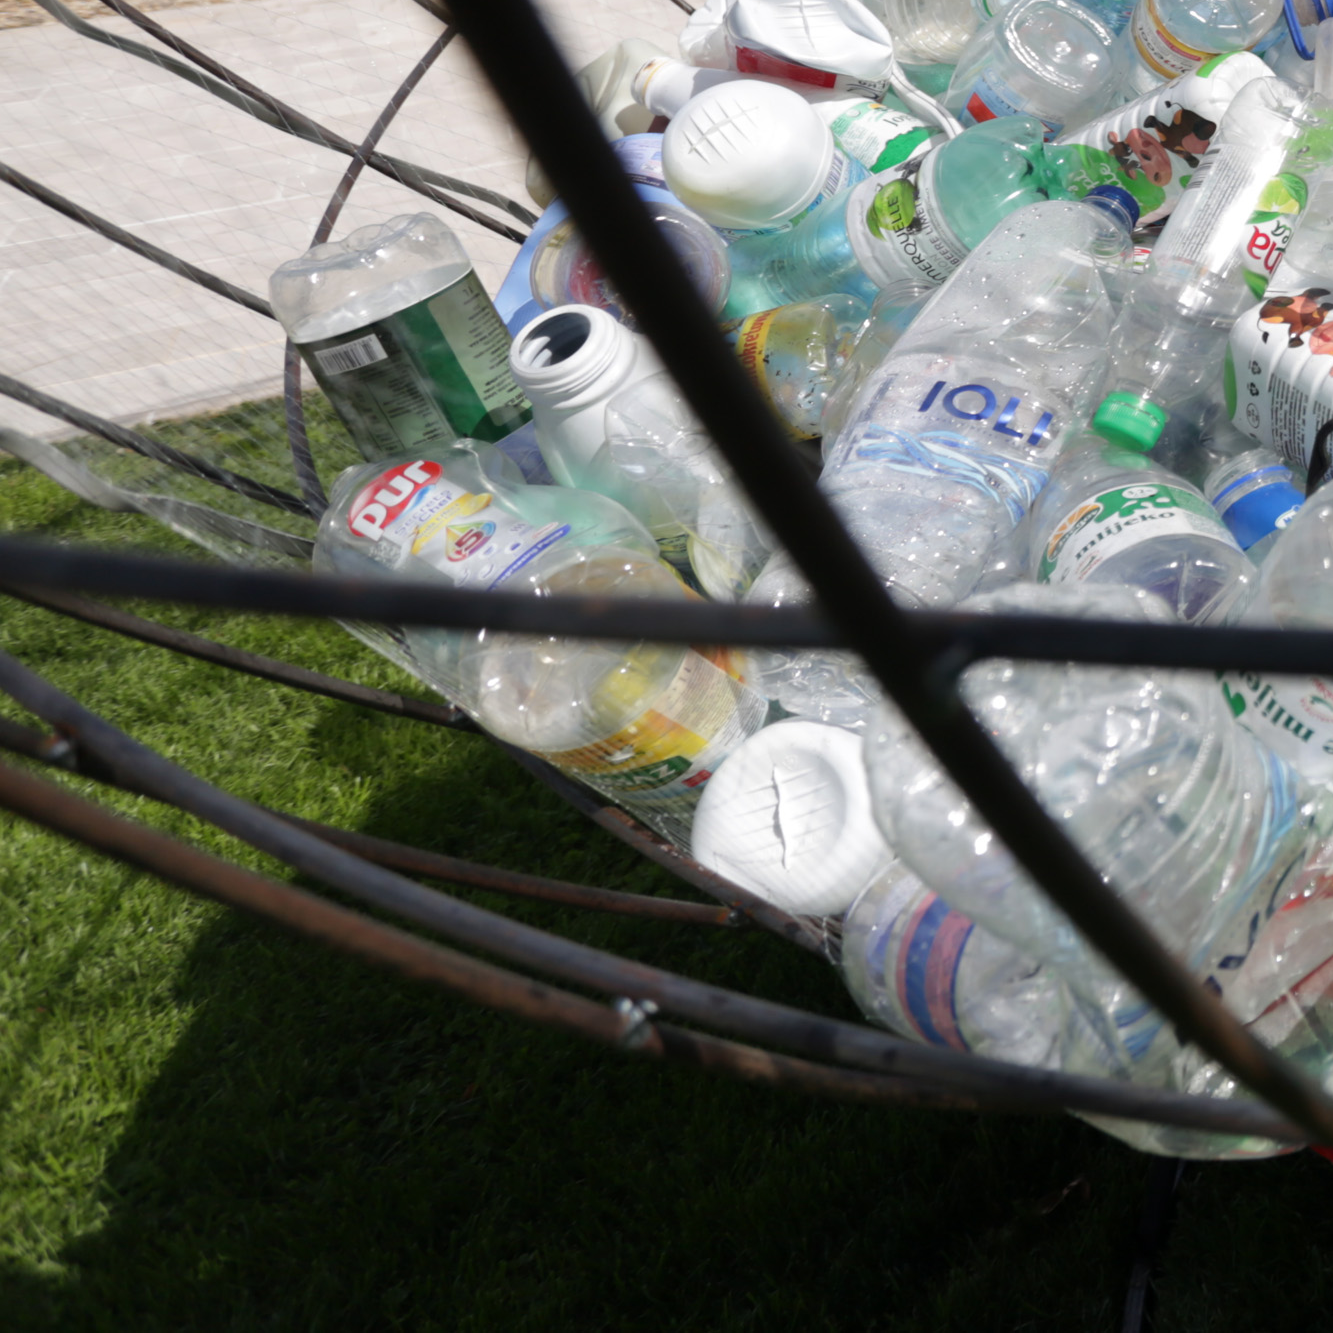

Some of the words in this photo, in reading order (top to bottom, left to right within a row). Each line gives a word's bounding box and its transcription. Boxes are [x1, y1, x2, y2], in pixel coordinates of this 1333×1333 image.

[928, 236, 961, 268] BEERE
[1246, 225, 1283, 275] na
[351, 459, 432, 543] pur
[1075, 511, 1176, 561] mlijeko
[1240, 670, 1316, 744] mlije
